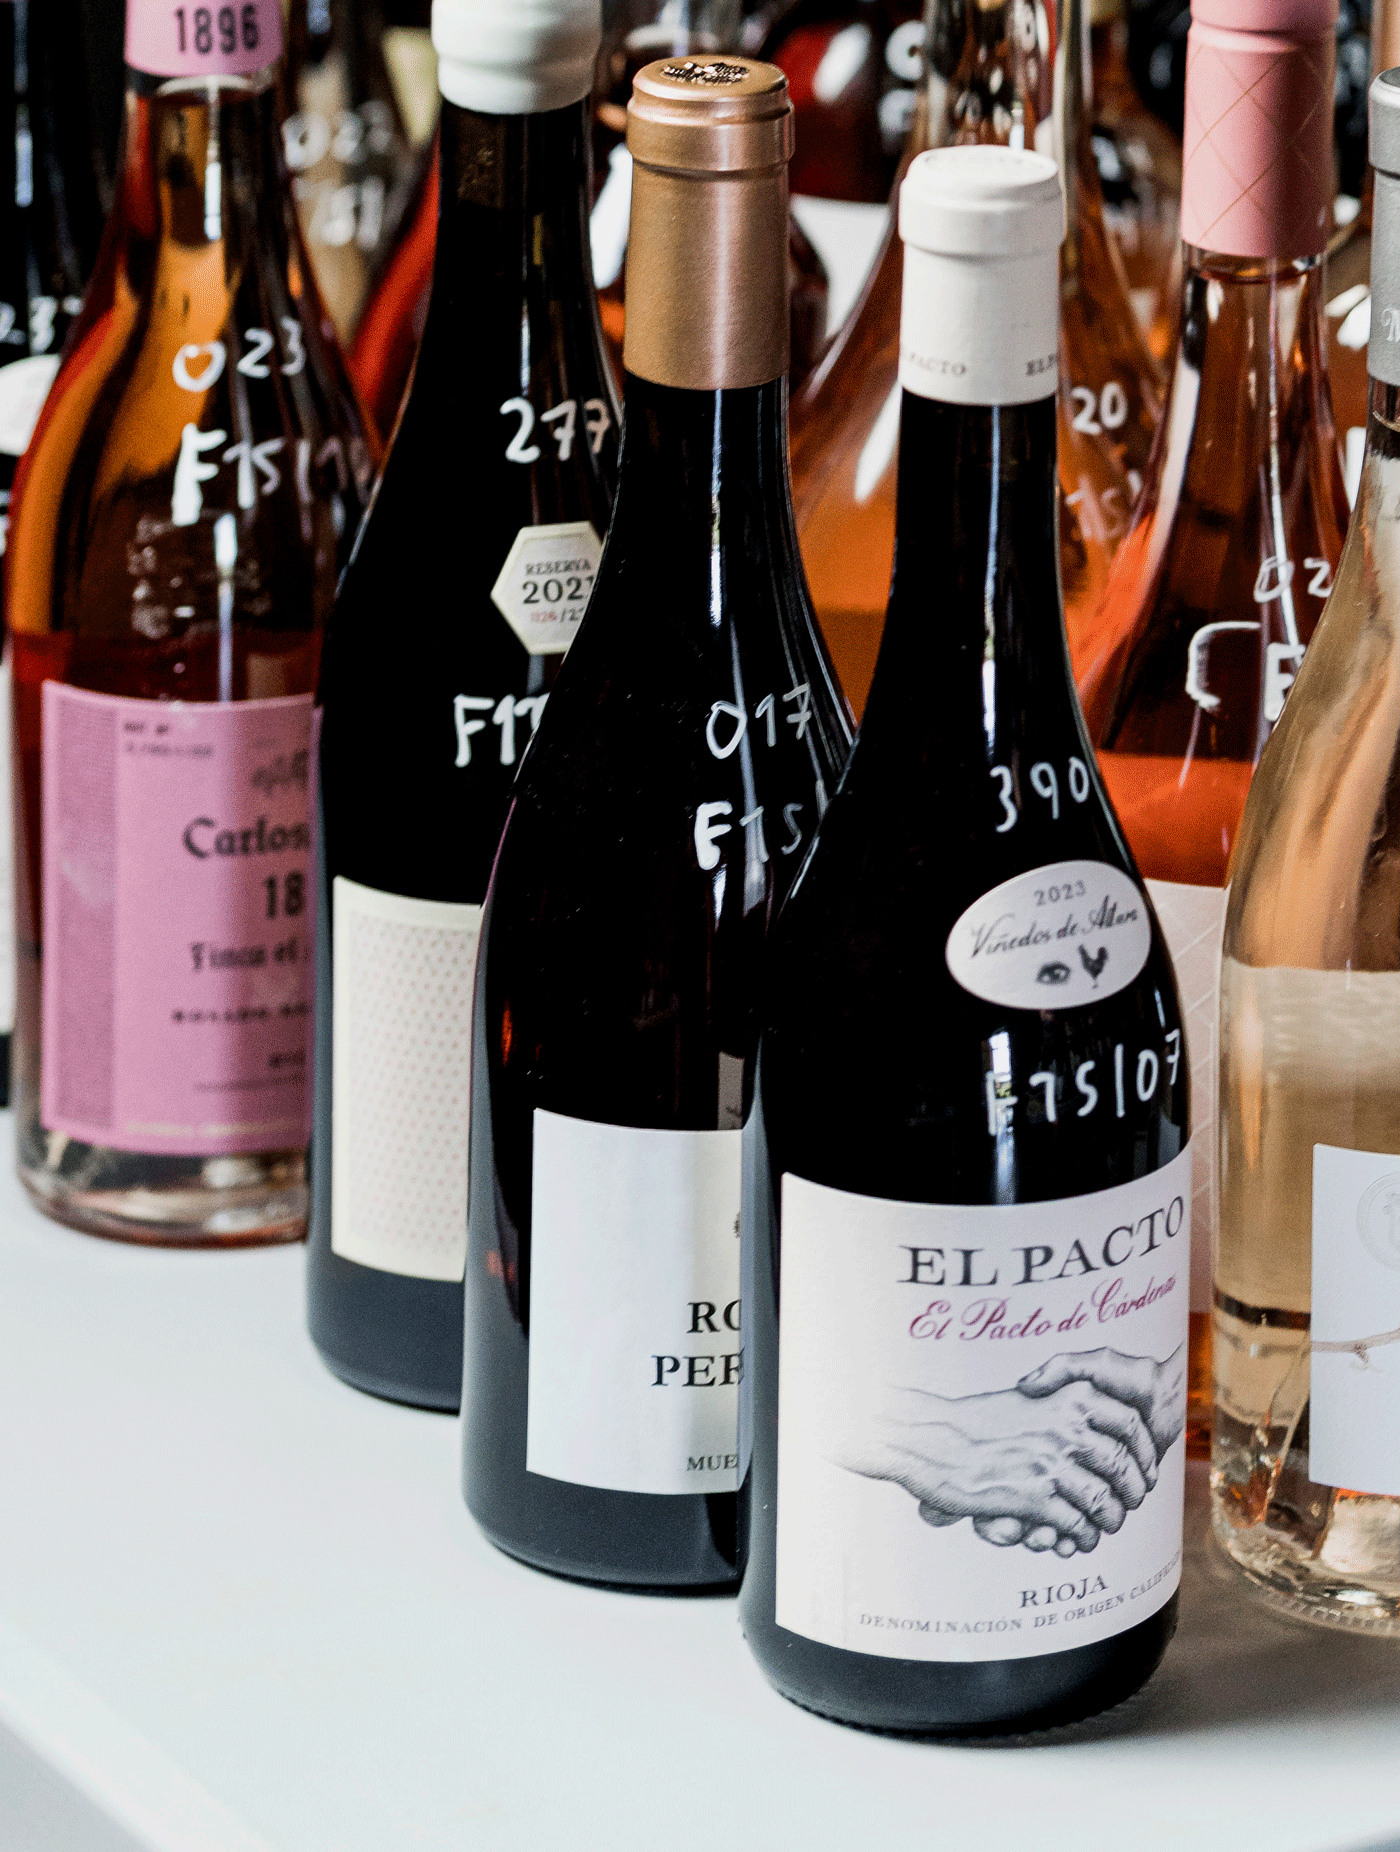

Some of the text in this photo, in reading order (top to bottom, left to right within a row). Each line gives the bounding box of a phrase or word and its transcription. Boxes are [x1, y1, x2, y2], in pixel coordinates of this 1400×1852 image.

[173, 4, 259, 55] 1896
[500, 397, 611, 464] 277
[989, 755, 1090, 834] 390
[971, 912, 1051, 959] Viñedos
[1056, 913, 1079, 940] de
[896, 1195, 1185, 1287] EL PACTO
[909, 1299, 952, 1341] El
[958, 1297, 1051, 1342] Pacto
[1056, 1301, 1090, 1335] de
[1018, 1573, 1109, 1608] RIOJA
[1033, 1612, 1058, 1629] DE
[1063, 1591, 1126, 1623] ORIGEN
